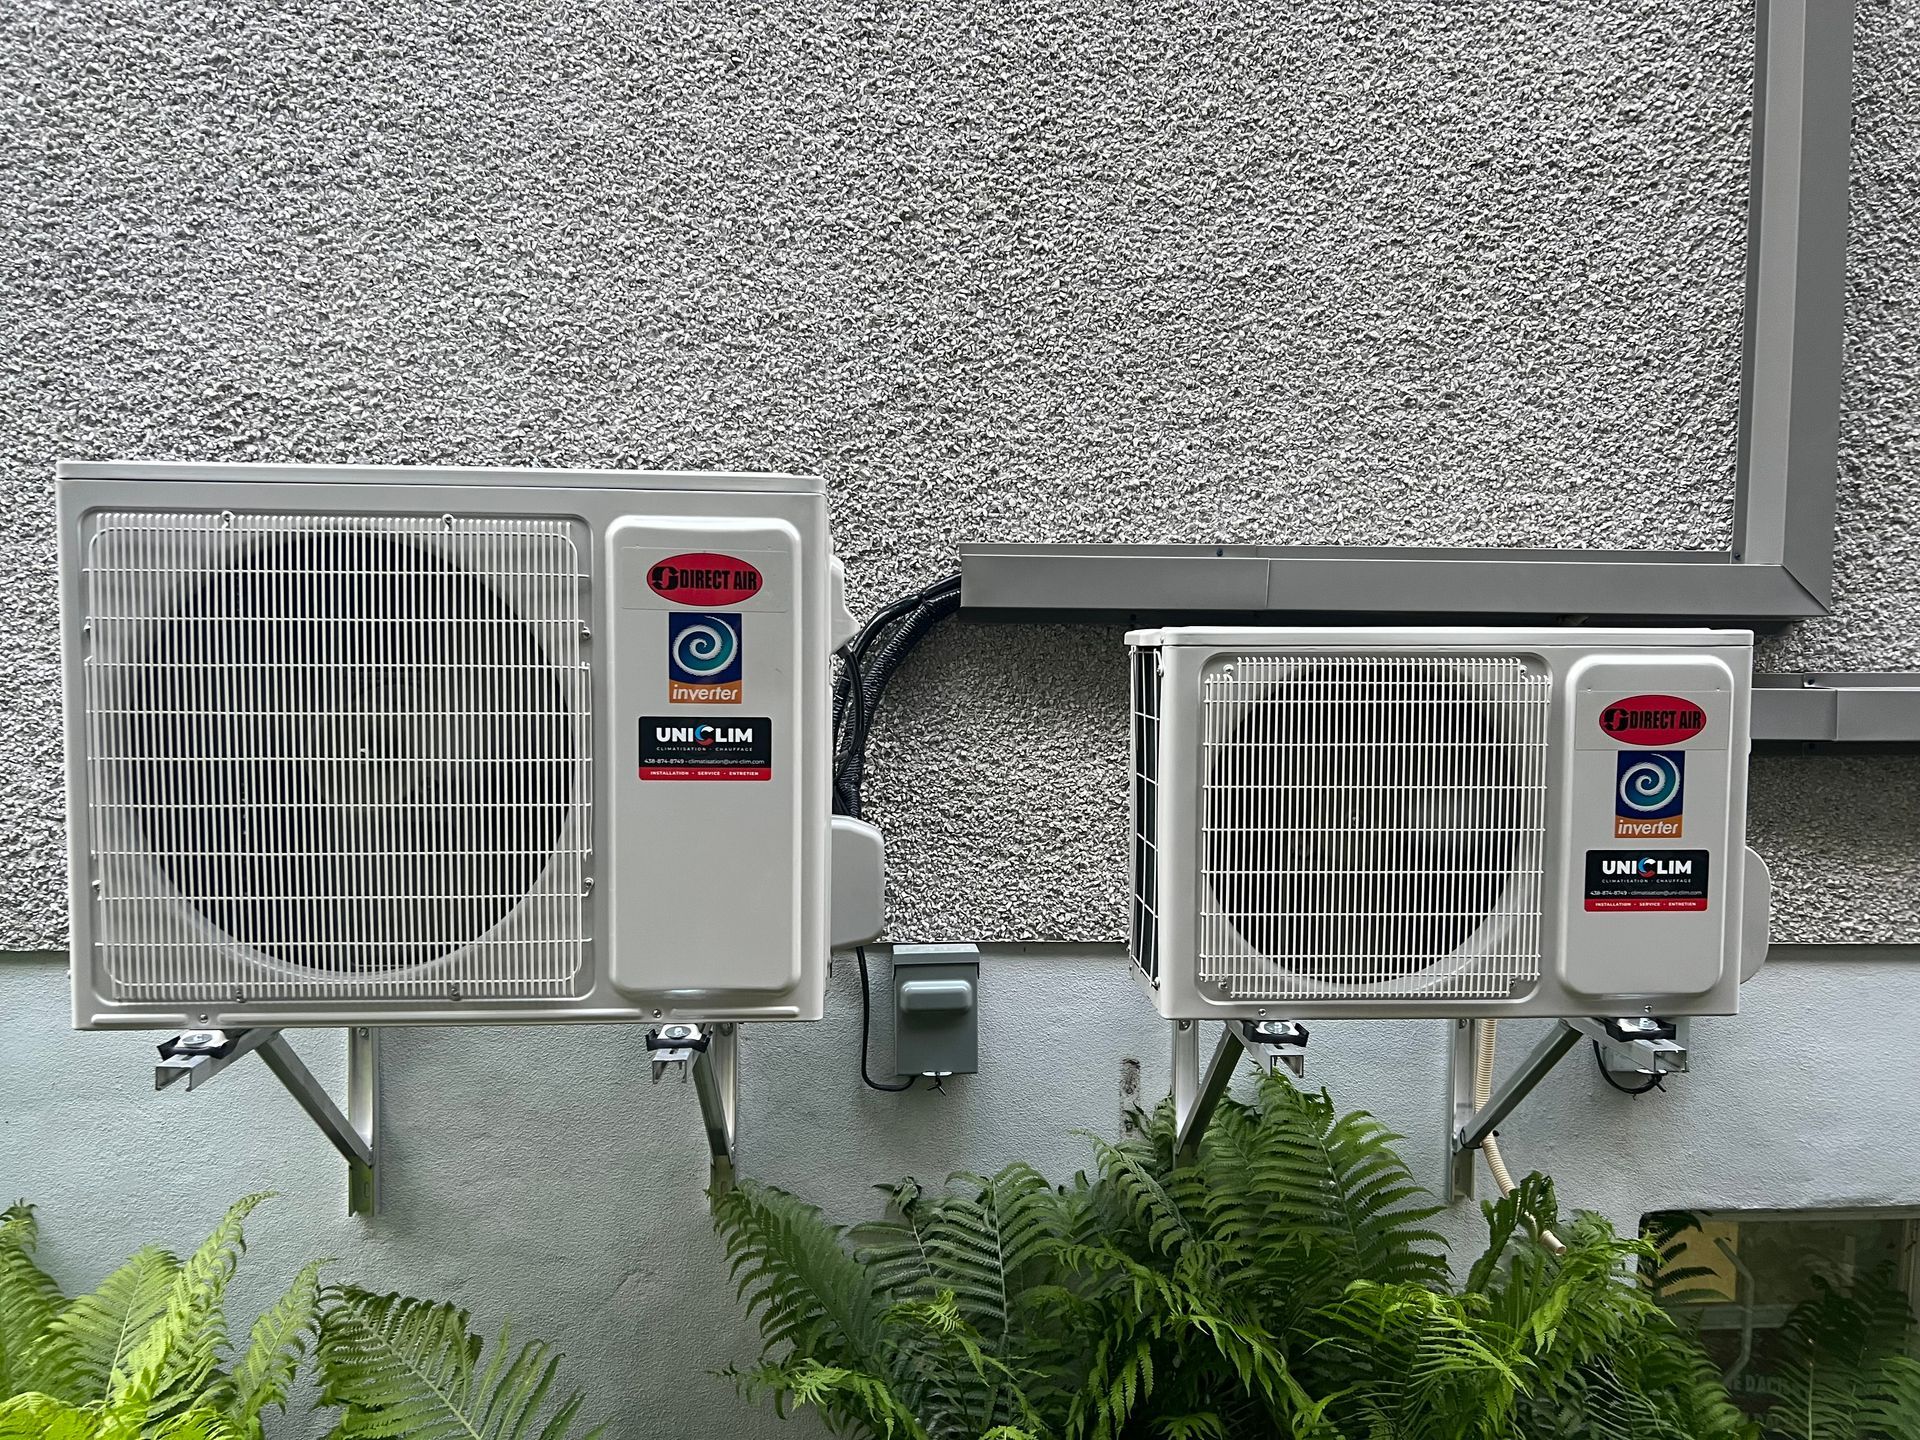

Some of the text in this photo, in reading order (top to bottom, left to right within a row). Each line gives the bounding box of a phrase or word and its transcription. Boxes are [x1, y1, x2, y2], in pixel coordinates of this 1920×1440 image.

[679, 569, 757, 591] DIRECT AIR
[672, 684, 738, 701] inverter
[1629, 710, 1701, 730] DIRECT AIR
[656, 724, 753, 746] UNICLIM
[1617, 820, 1679, 836] inverter
[1602, 857, 1692, 878] UNICLIM
